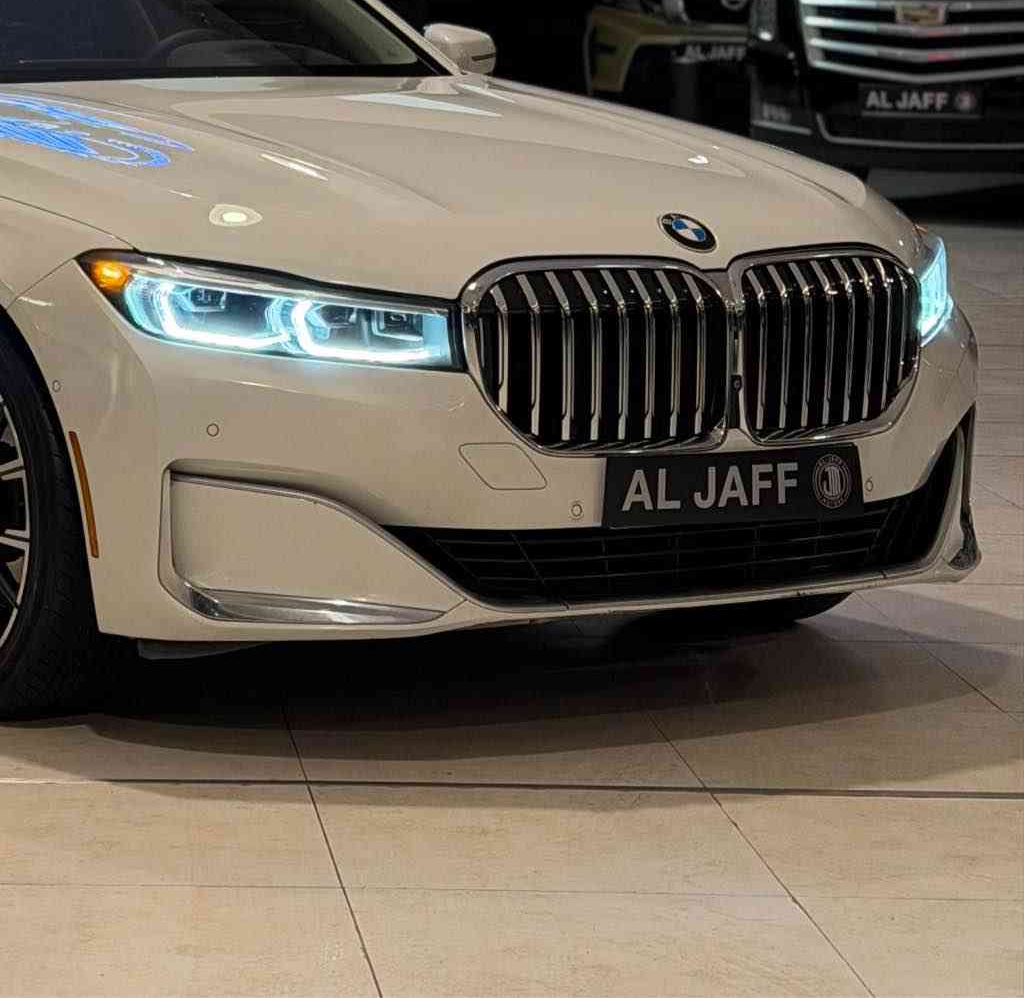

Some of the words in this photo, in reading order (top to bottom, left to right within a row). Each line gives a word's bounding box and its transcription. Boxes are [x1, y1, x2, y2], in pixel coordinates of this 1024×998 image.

[865, 90, 893, 109] AL
[896, 90, 949, 111] JAFF
[621, 468, 681, 512] AL
[693, 462, 799, 510] JAFF
